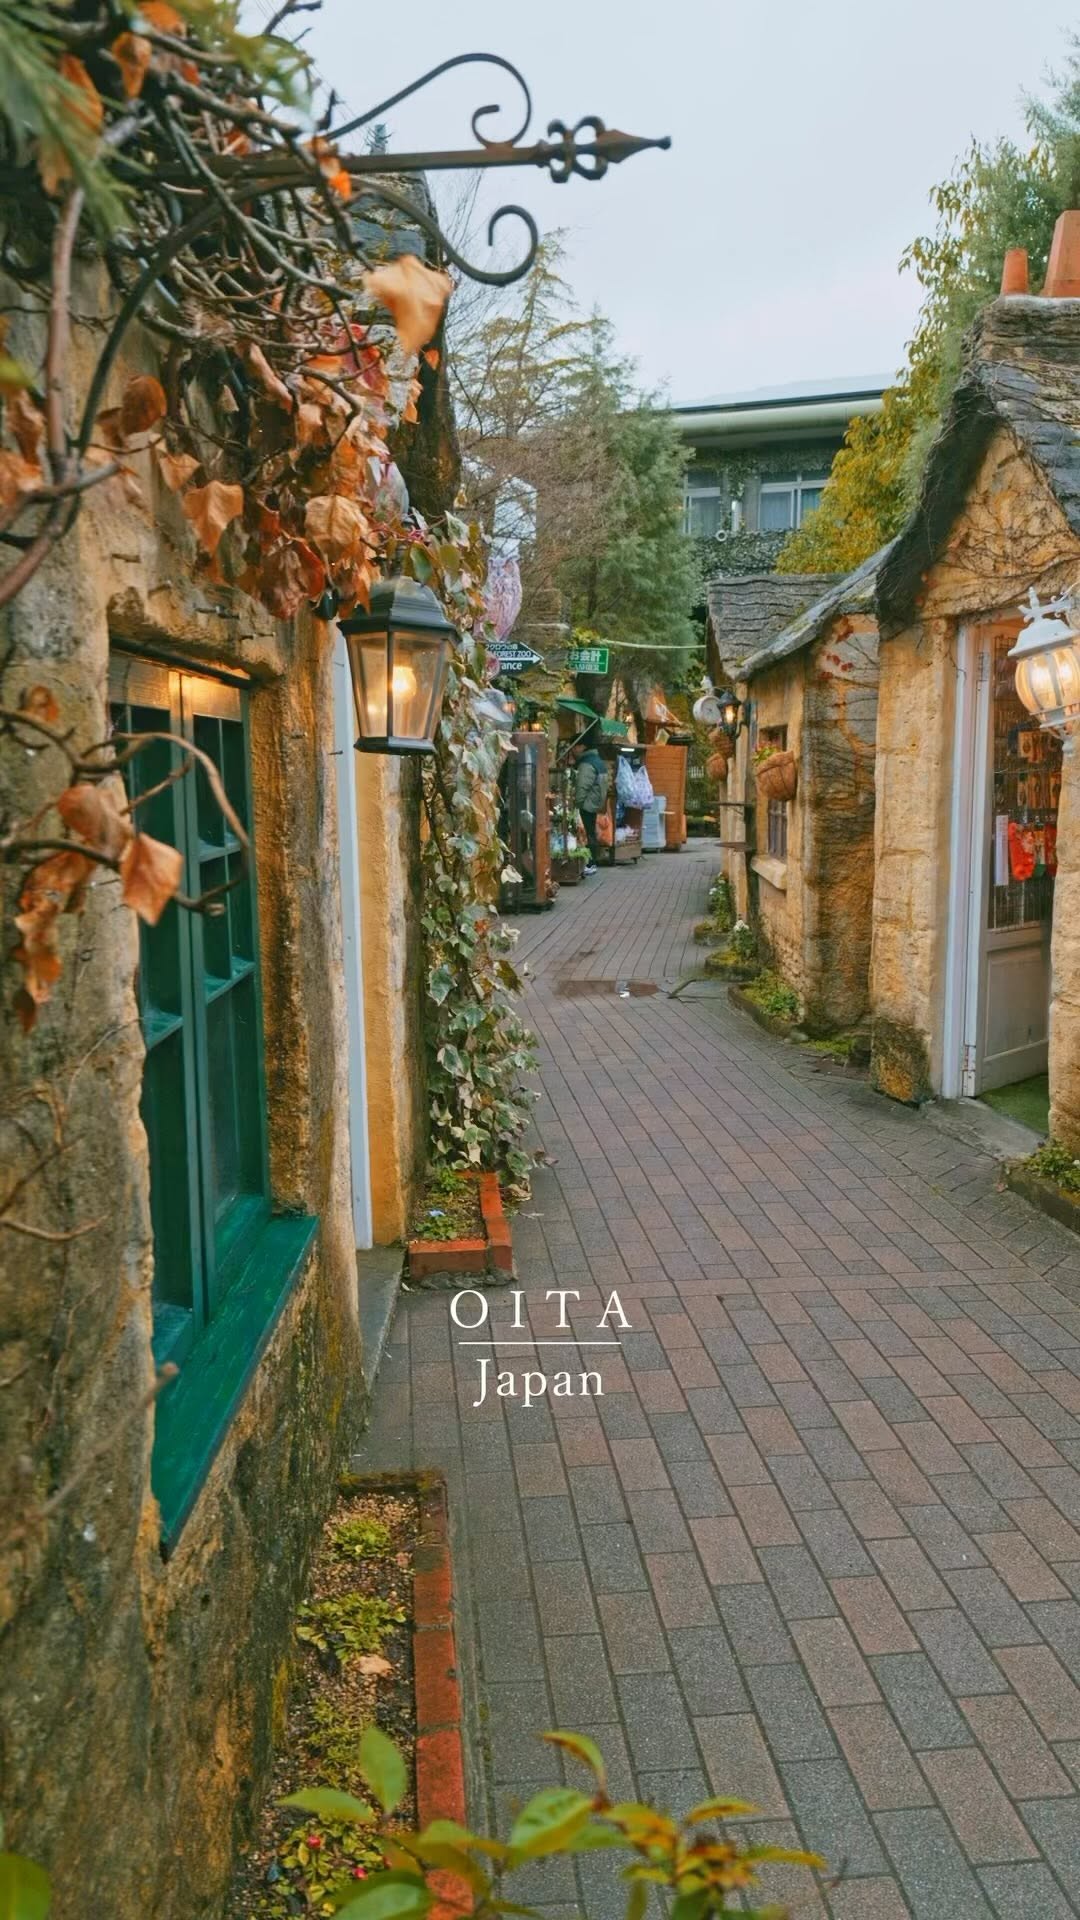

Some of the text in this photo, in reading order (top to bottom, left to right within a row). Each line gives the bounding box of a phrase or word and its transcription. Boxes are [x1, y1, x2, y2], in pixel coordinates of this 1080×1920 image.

[569, 650, 602, 662] お会計
[501, 662, 523, 670] ance
